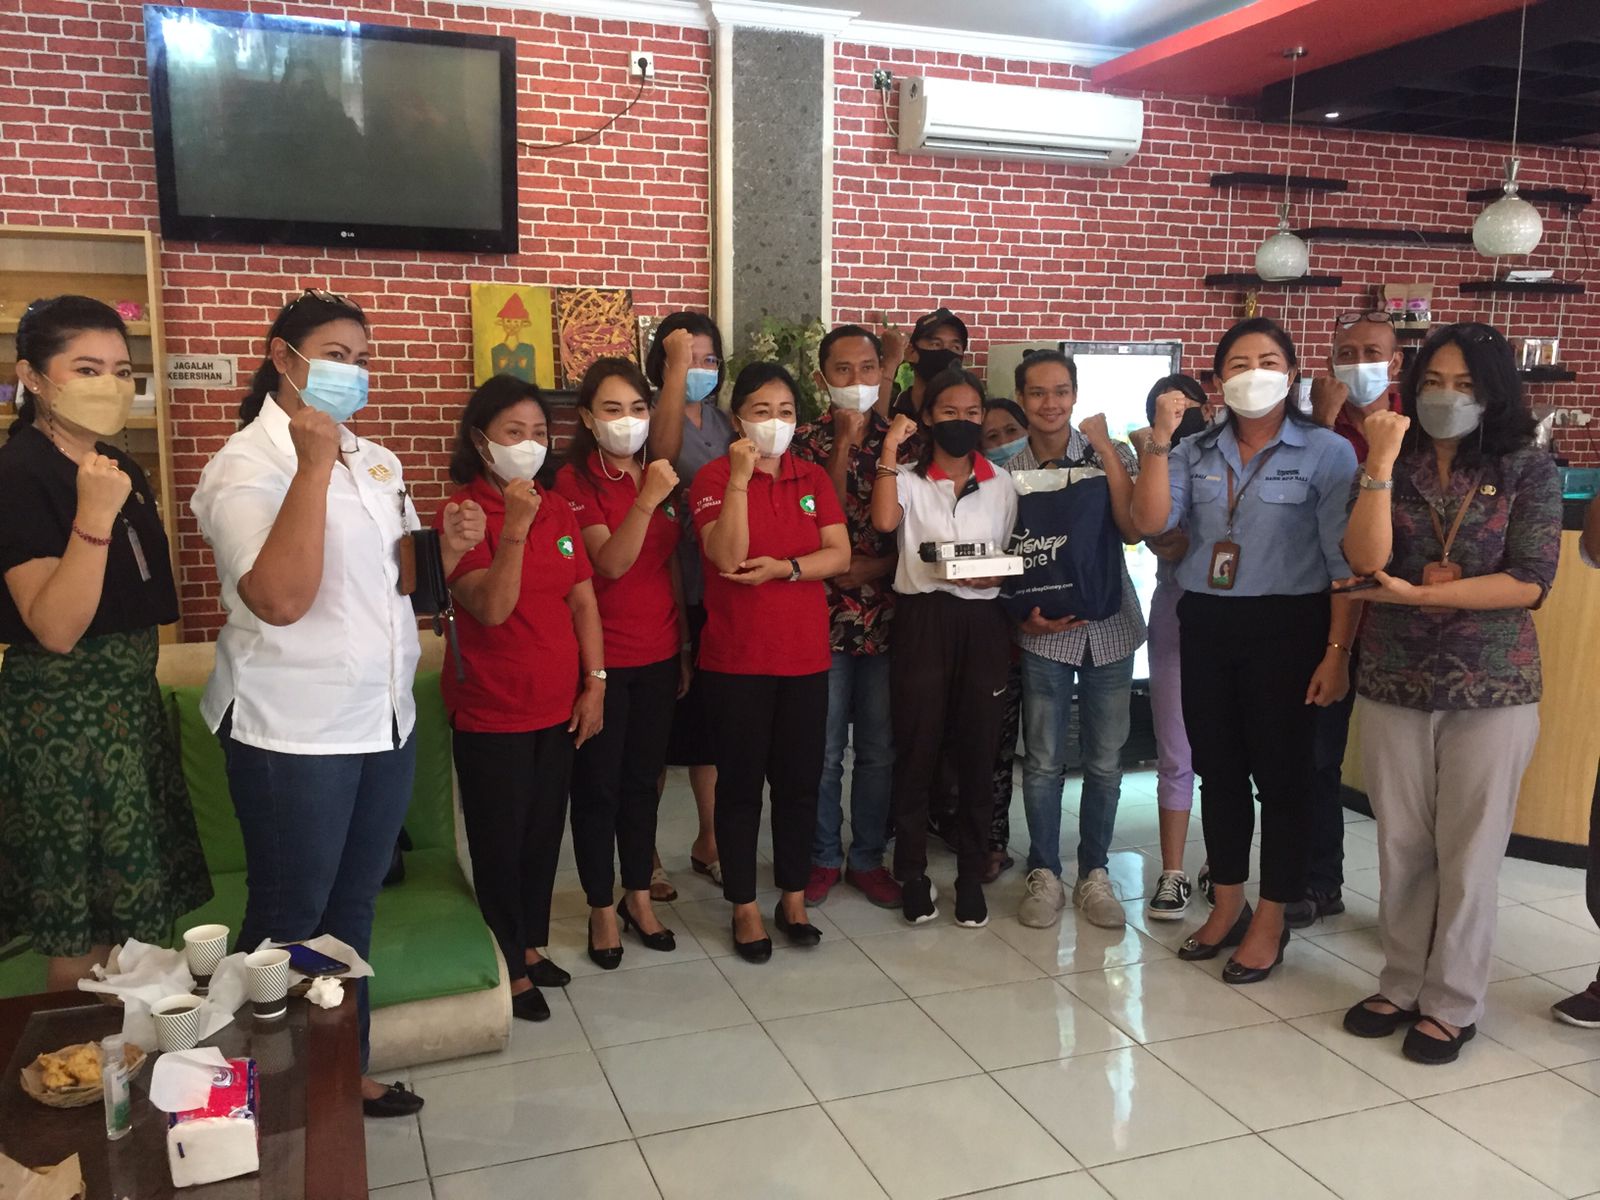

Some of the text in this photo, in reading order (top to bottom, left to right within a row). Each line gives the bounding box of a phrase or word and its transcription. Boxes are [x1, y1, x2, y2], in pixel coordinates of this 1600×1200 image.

[174, 362, 213, 370] JAGALAH
[167, 372, 222, 380] KEBERSIHAN
[1023, 553, 1048, 569] ore
